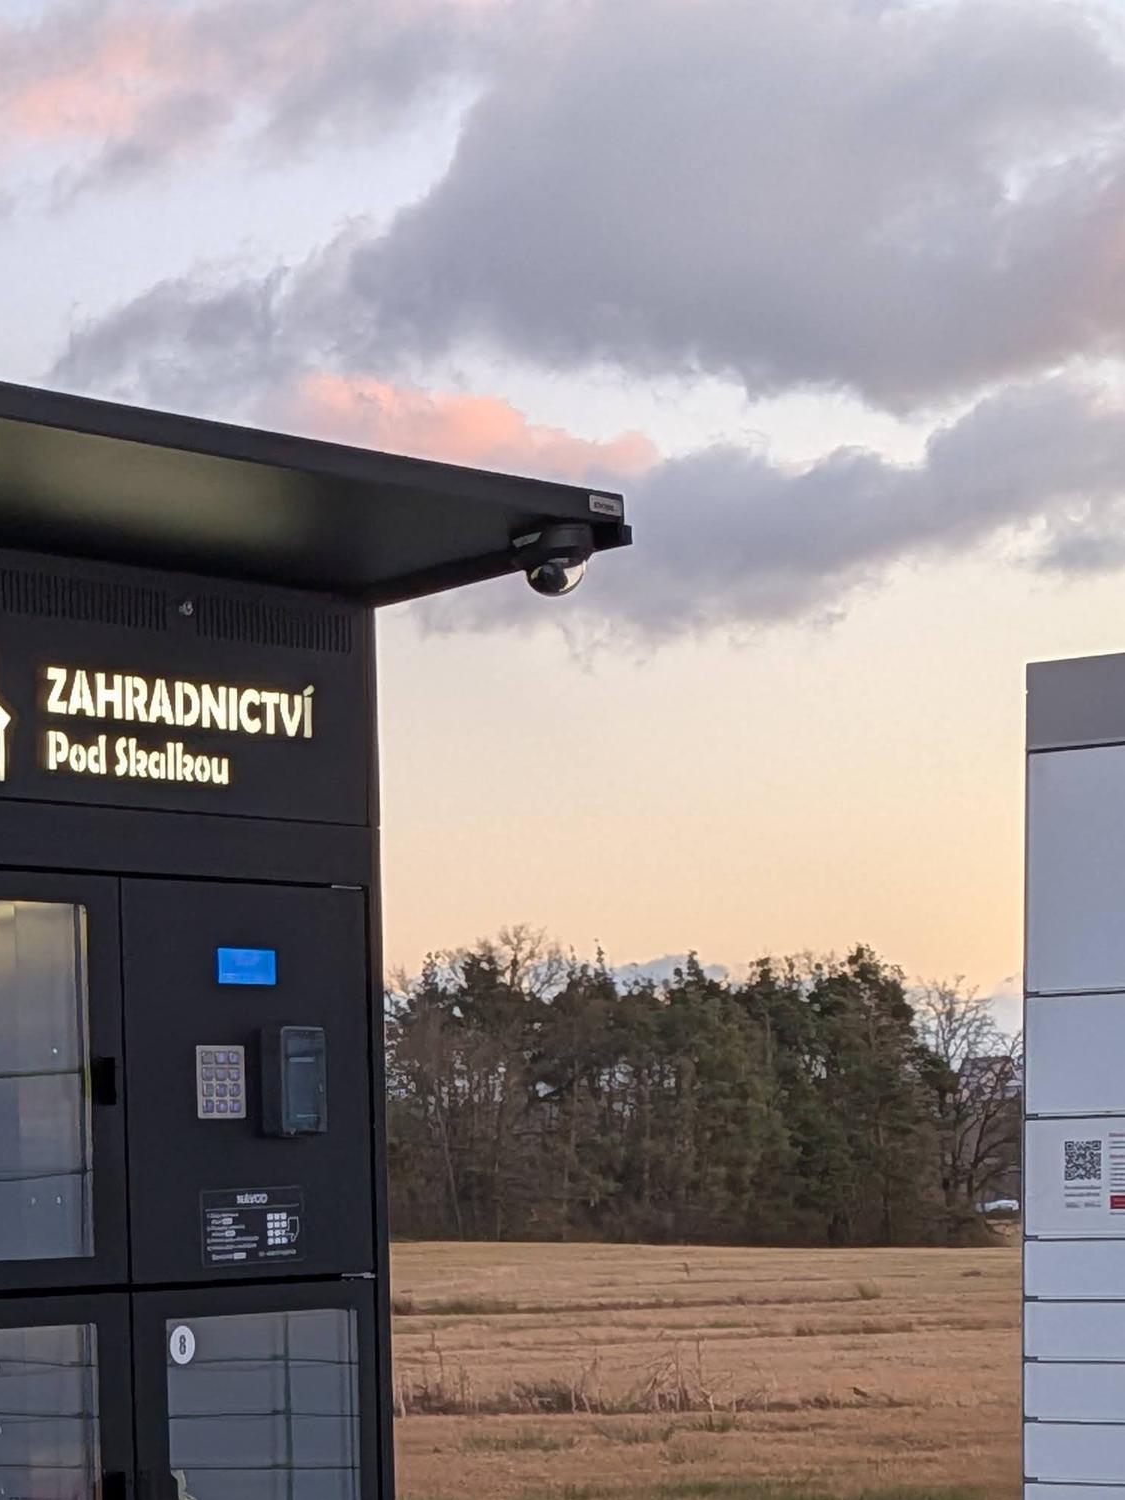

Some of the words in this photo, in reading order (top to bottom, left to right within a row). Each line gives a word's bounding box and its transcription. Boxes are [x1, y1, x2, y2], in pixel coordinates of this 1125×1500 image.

[46, 666, 315, 738] ZAHRADNICTVÍ
[47, 730, 107, 775] Pod
[114, 737, 229, 785] Skalkou
[178, 1334, 187, 1356] 8
